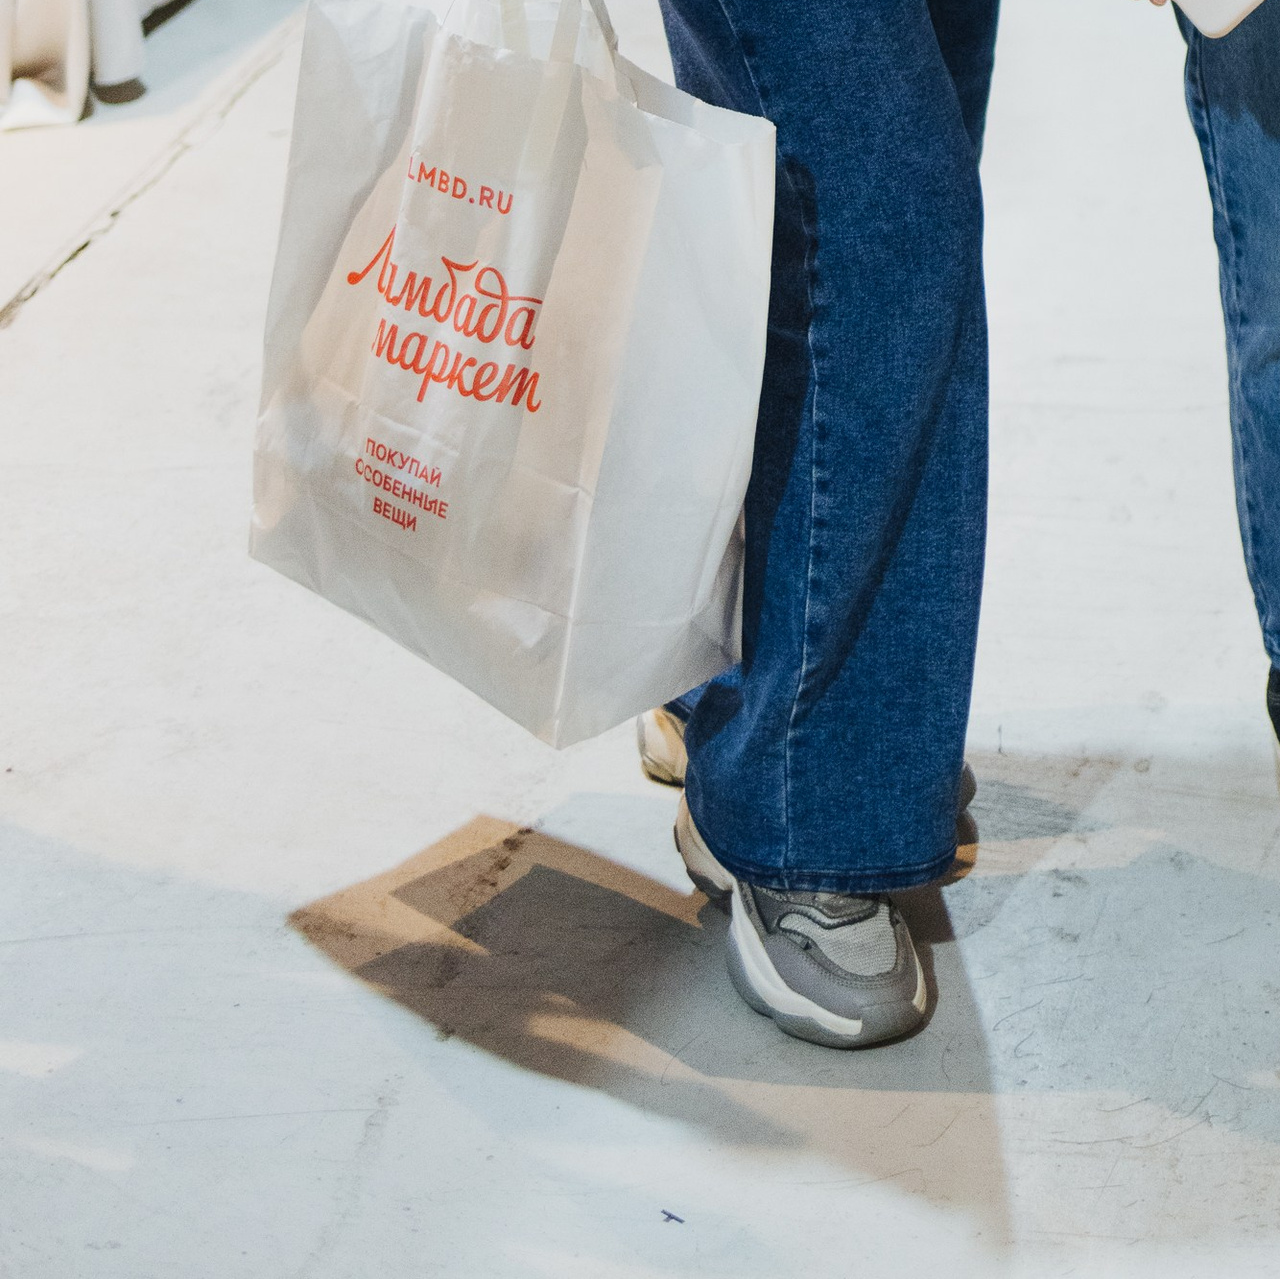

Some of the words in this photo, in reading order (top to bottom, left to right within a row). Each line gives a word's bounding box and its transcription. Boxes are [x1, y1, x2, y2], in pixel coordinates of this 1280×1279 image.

[406, 156, 514, 215] LMBD.RU
[366, 437, 442, 488] ПОКУПАЙ
[373, 496, 417, 532] ВЕЩИ
